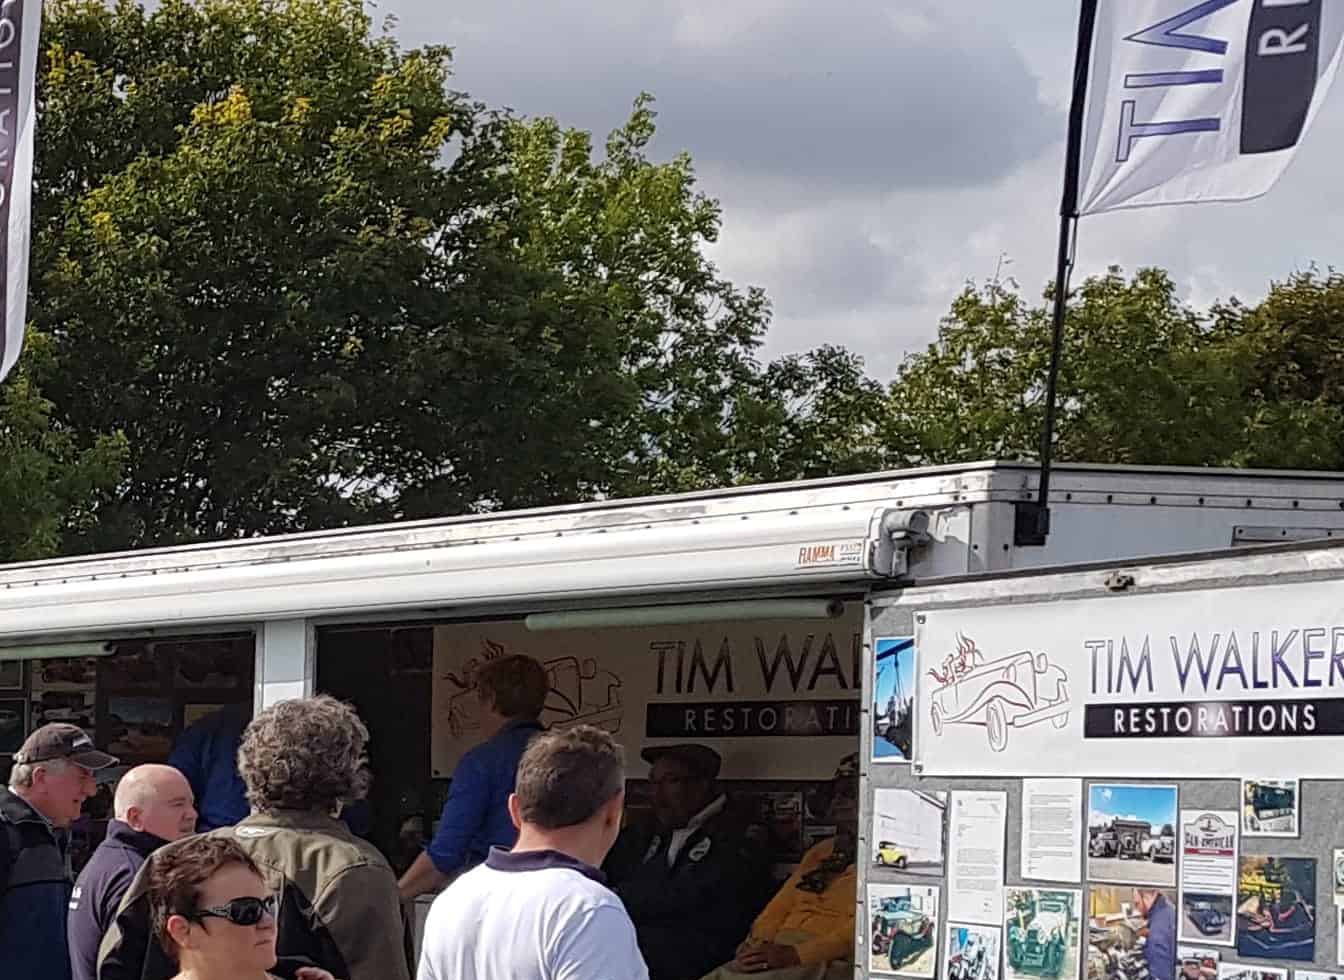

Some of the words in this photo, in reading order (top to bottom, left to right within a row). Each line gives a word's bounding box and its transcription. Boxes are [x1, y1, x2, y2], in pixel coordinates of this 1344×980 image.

[649, 635, 734, 695] TIM
[1083, 634, 1154, 695] TIM
[1169, 626, 1344, 694] WALKER
[1113, 704, 1317, 734] RESTORATIONS
